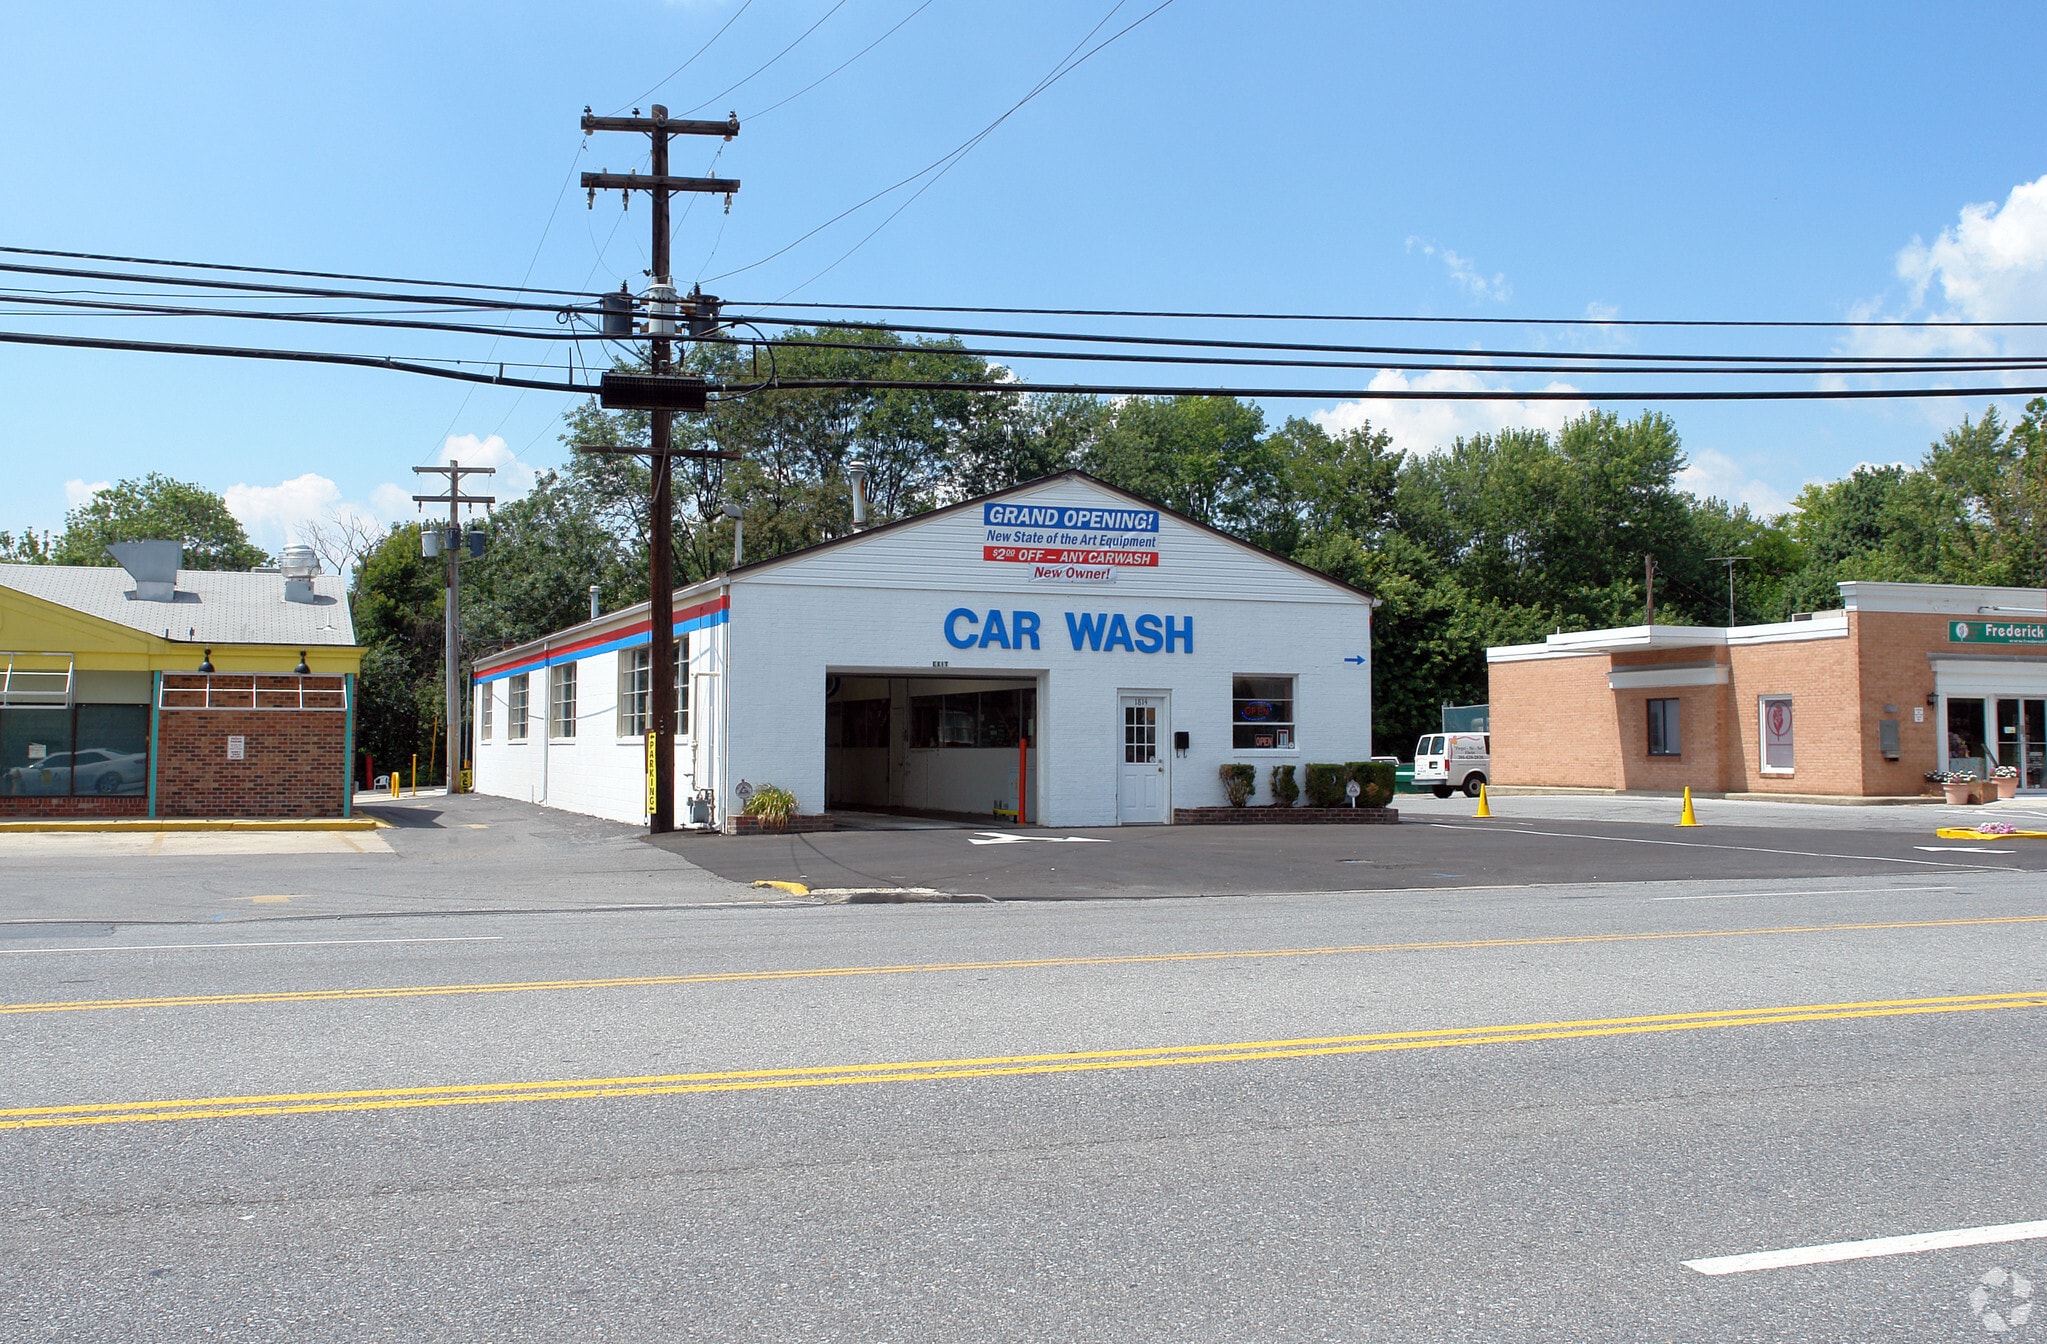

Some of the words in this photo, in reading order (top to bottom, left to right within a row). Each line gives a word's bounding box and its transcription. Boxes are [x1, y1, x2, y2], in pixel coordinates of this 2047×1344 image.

[989, 506, 1059, 526] GRAND
[1063, 509, 1154, 530] OPENING!
[986, 529, 1012, 542] New
[1013, 531, 1044, 543] State
[1046, 532, 1059, 544] of
[1060, 533, 1078, 545] the
[1079, 534, 1098, 546] Art
[1099, 534, 1157, 549] Equipment
[1018, 549, 1045, 562] OFF
[1059, 551, 1087, 563] ANY
[1088, 551, 1151, 565] CARWASH
[1034, 566, 1063, 579] New
[1065, 567, 1111, 580] Owner!
[943, 607, 1041, 650] CAR
[1064, 611, 1194, 654] WASH
[1985, 623, 2045, 638] Frederick
[1244, 705, 1269, 716] OPEN
[1255, 736, 1274, 747] OPEN
